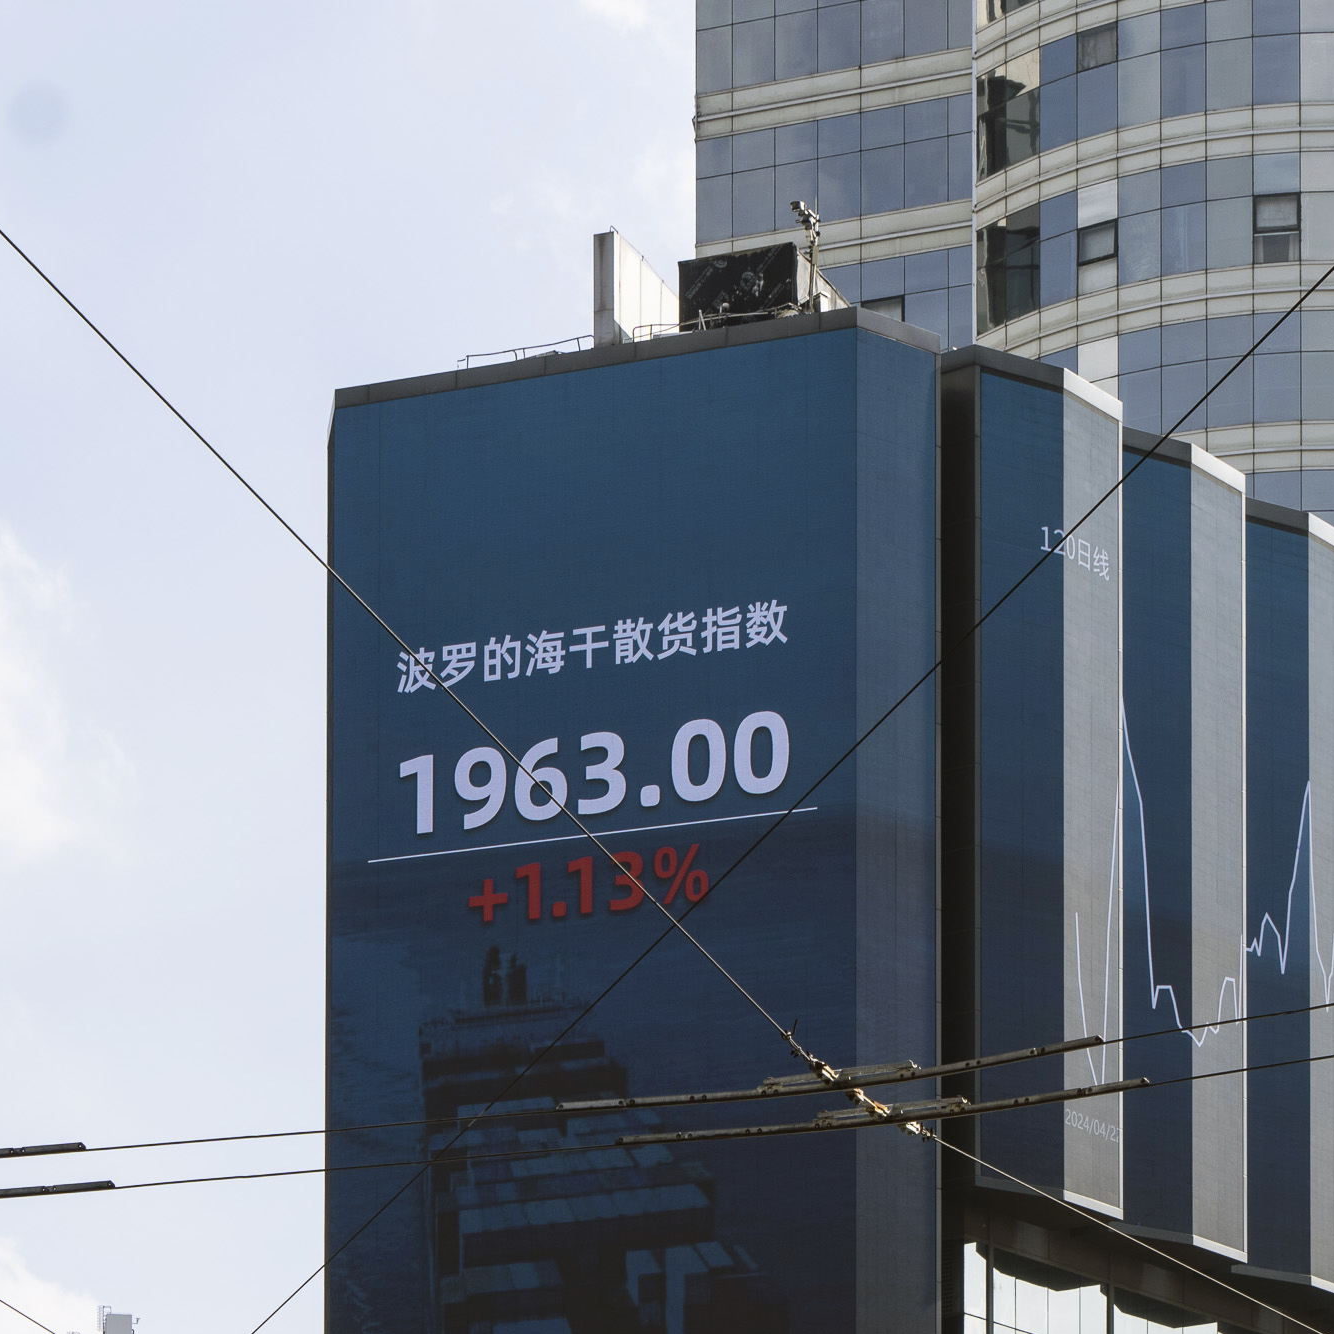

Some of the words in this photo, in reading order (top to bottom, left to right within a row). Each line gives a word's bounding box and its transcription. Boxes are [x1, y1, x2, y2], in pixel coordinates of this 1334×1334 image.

[1040, 526, 1110, 581] 120日线
[396, 600, 789, 694] 波罗的海干散货指数
[399, 711, 790, 834] 1963.00
[468, 843, 710, 923] +1.13%
[1065, 1108, 1120, 1143] 2024/04/2
